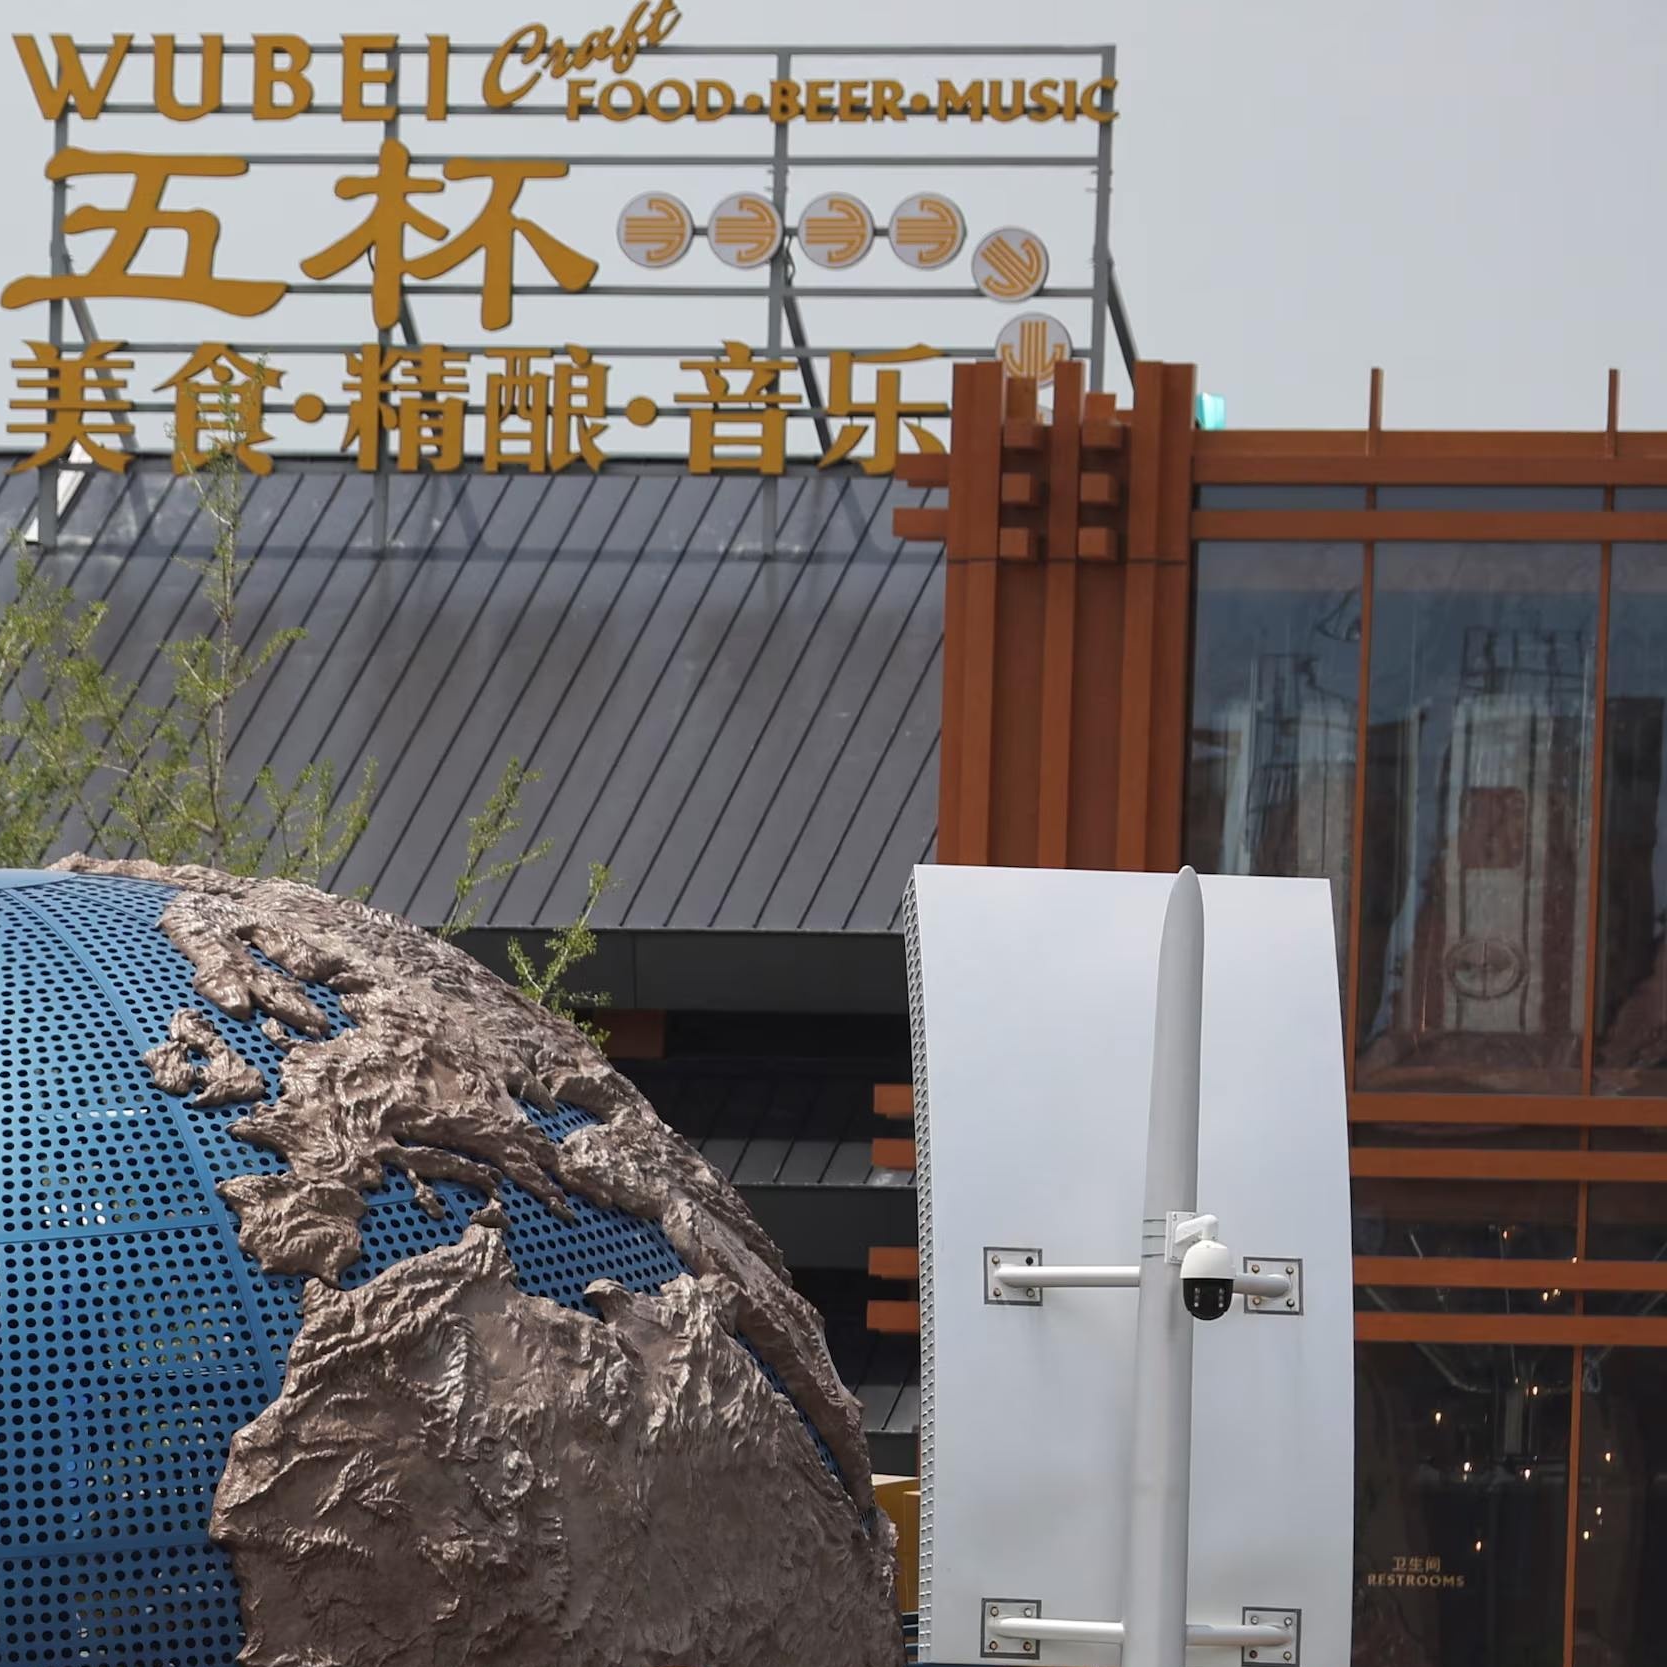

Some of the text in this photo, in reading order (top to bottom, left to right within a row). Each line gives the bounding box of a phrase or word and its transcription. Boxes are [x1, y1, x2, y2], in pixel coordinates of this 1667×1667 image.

[12, 0, 683, 122] WUBEI Craft
[0, 137, 599, 331] 五杯
[1367, 1573, 1465, 1588] RESTROOMS
[1392, 1556, 1441, 1573] 卫生间
